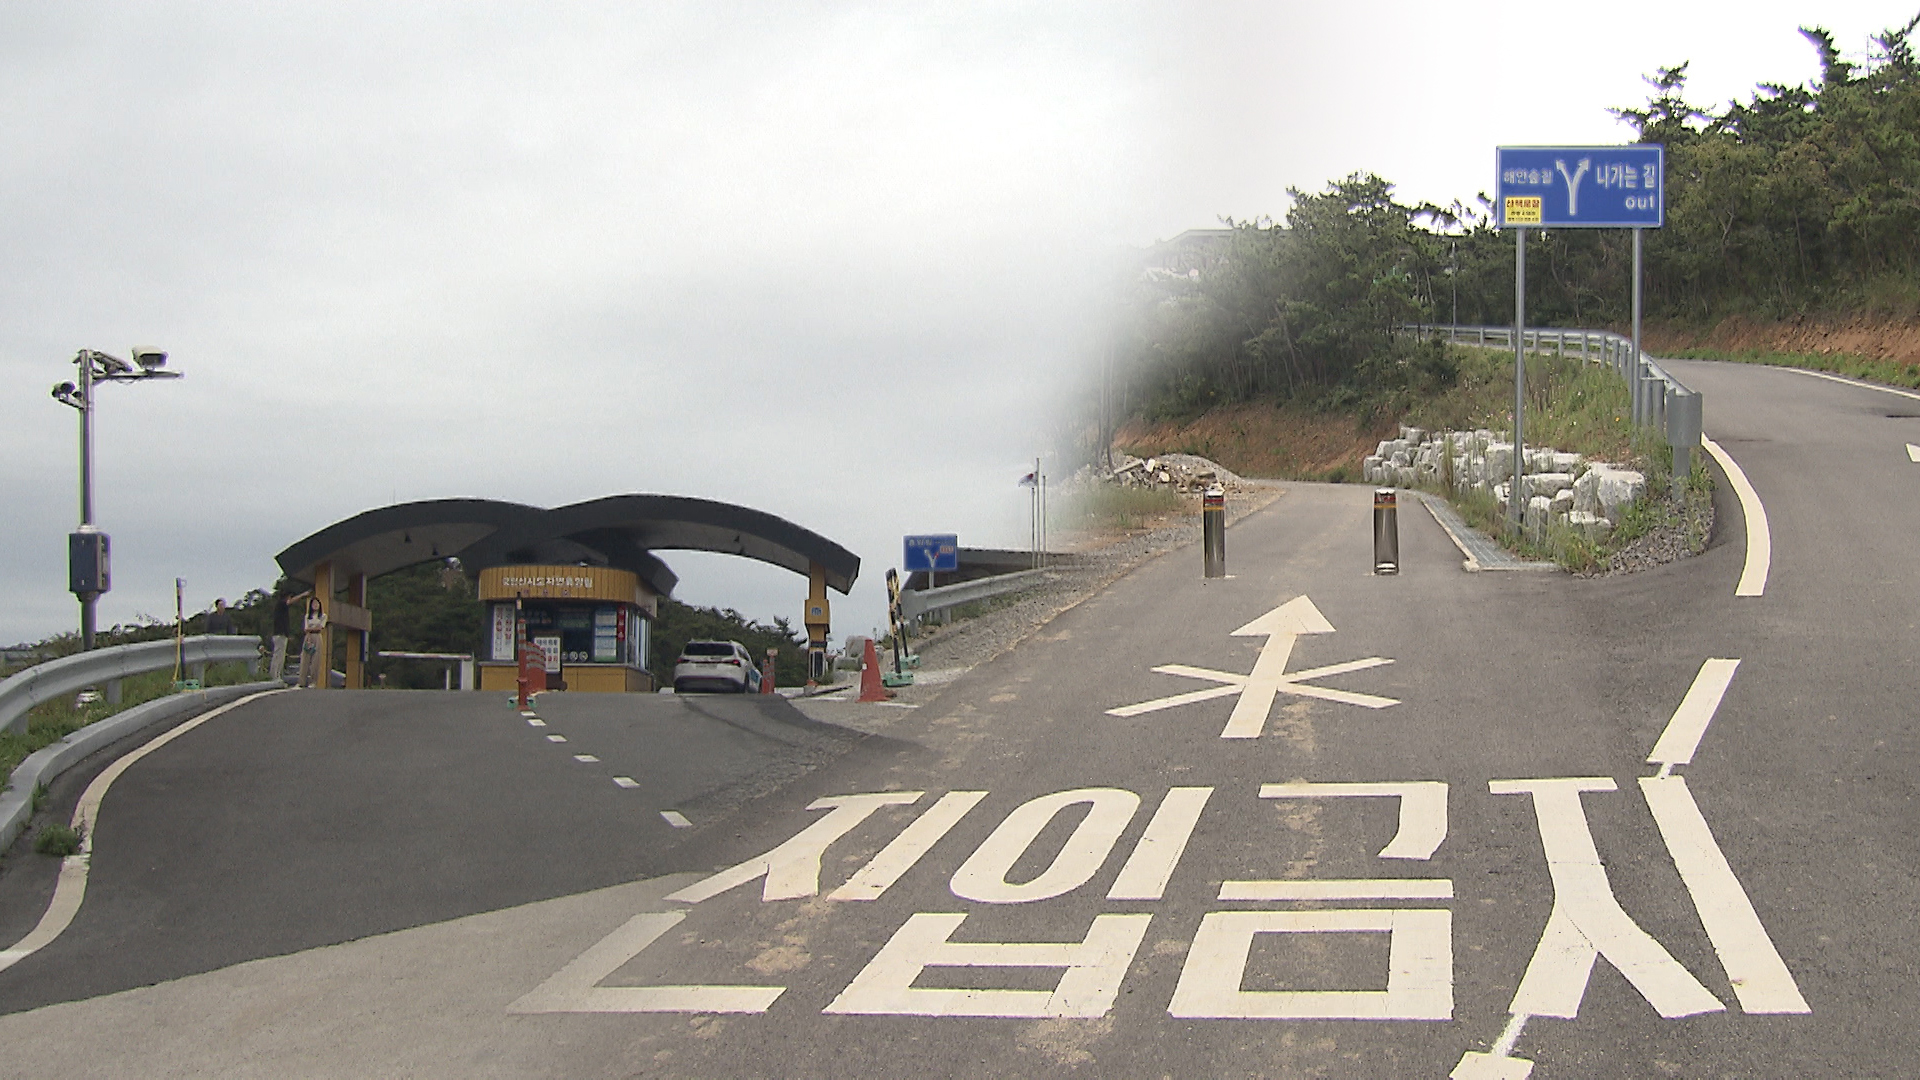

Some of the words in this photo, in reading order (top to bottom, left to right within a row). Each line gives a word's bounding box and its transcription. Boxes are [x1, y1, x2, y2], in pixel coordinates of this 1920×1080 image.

[1597, 164, 1638, 189] 나가는
[1643, 164, 1655, 189] 길
[508, 776, 1811, 1020] 진입금지
